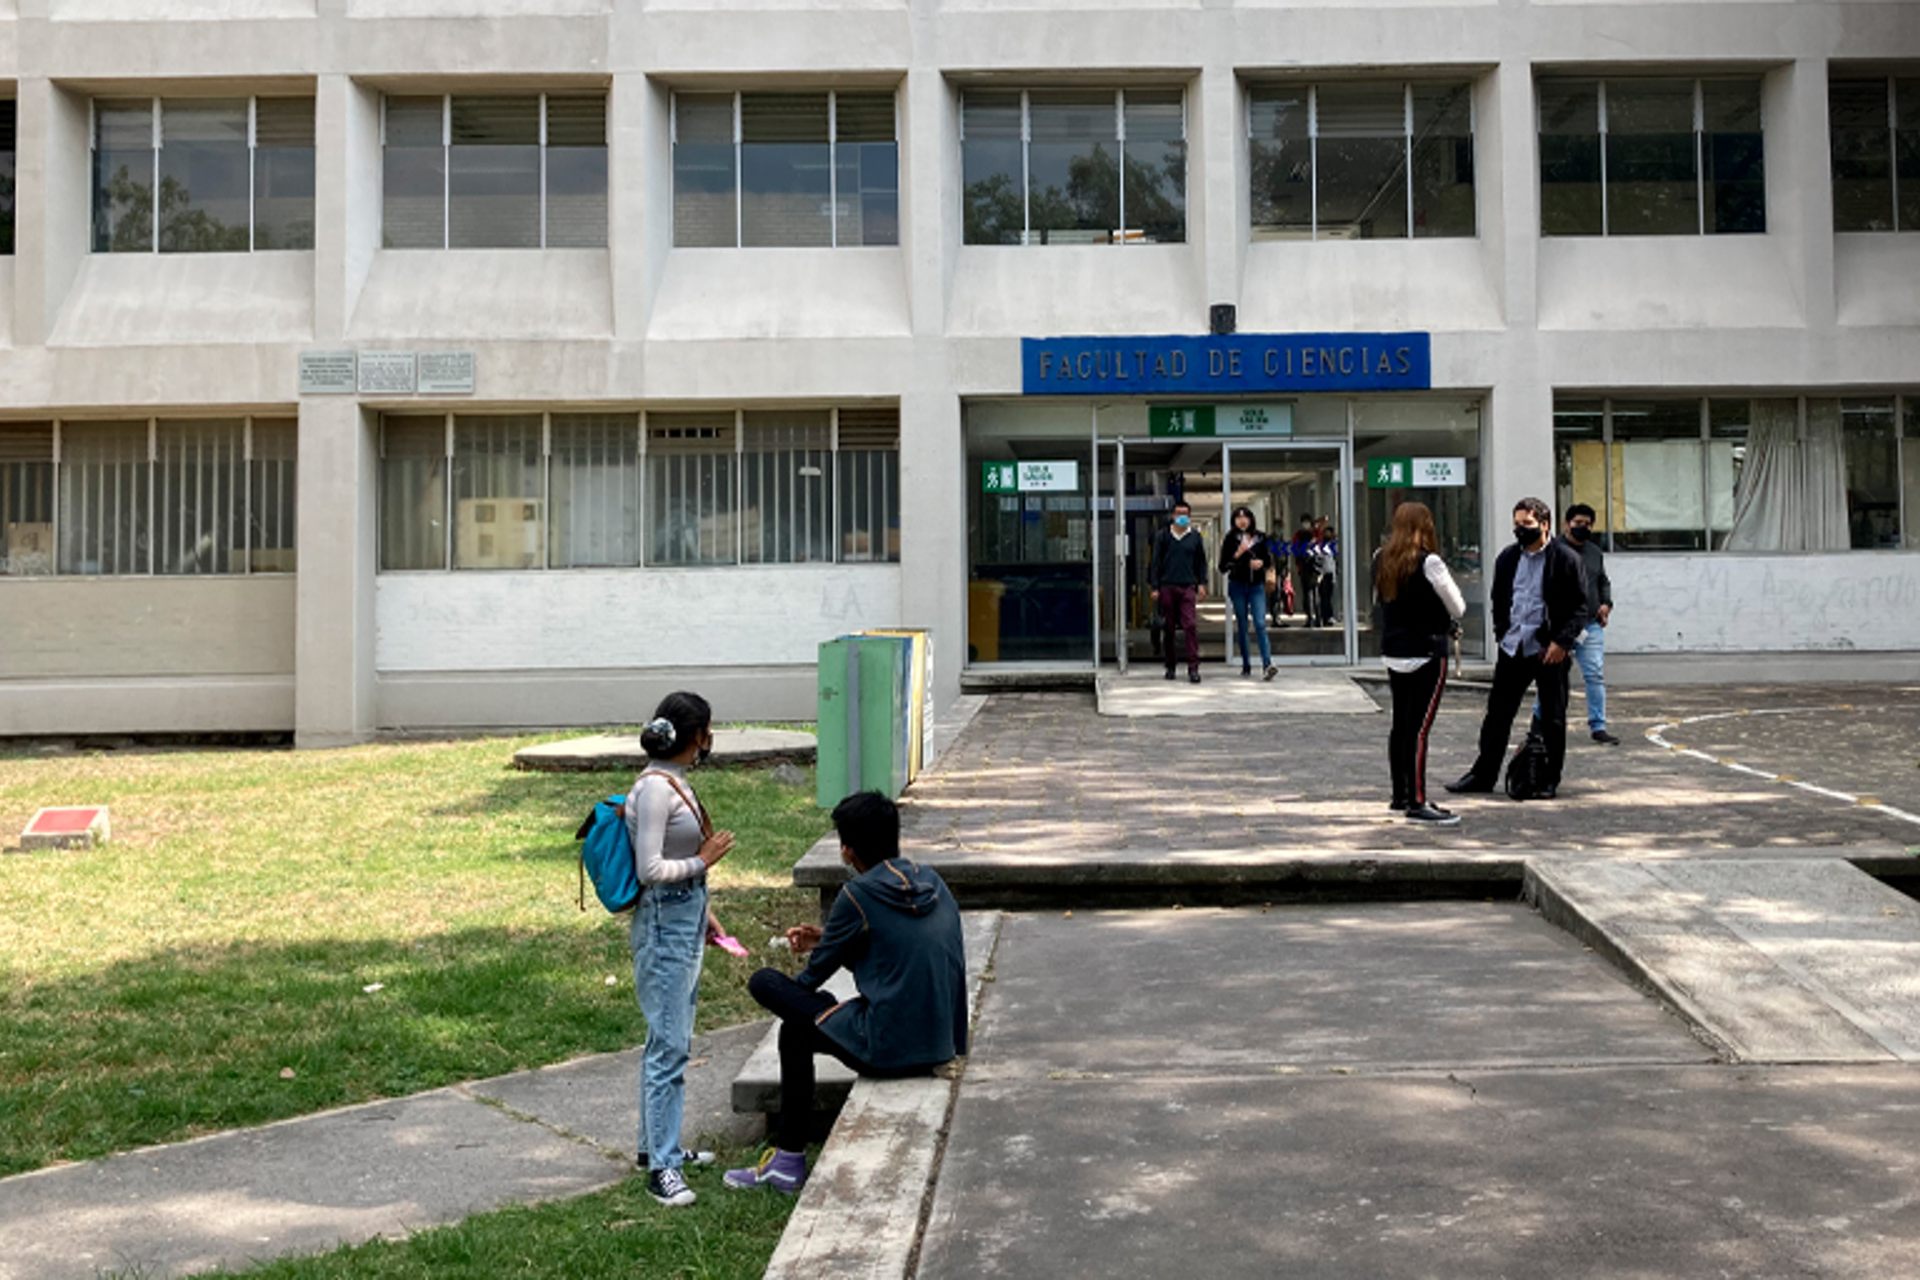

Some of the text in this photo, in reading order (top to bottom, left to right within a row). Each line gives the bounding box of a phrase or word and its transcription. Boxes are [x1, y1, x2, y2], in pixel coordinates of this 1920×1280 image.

[1039, 346, 1412, 380] FACULTAD DE CIENCIAS
